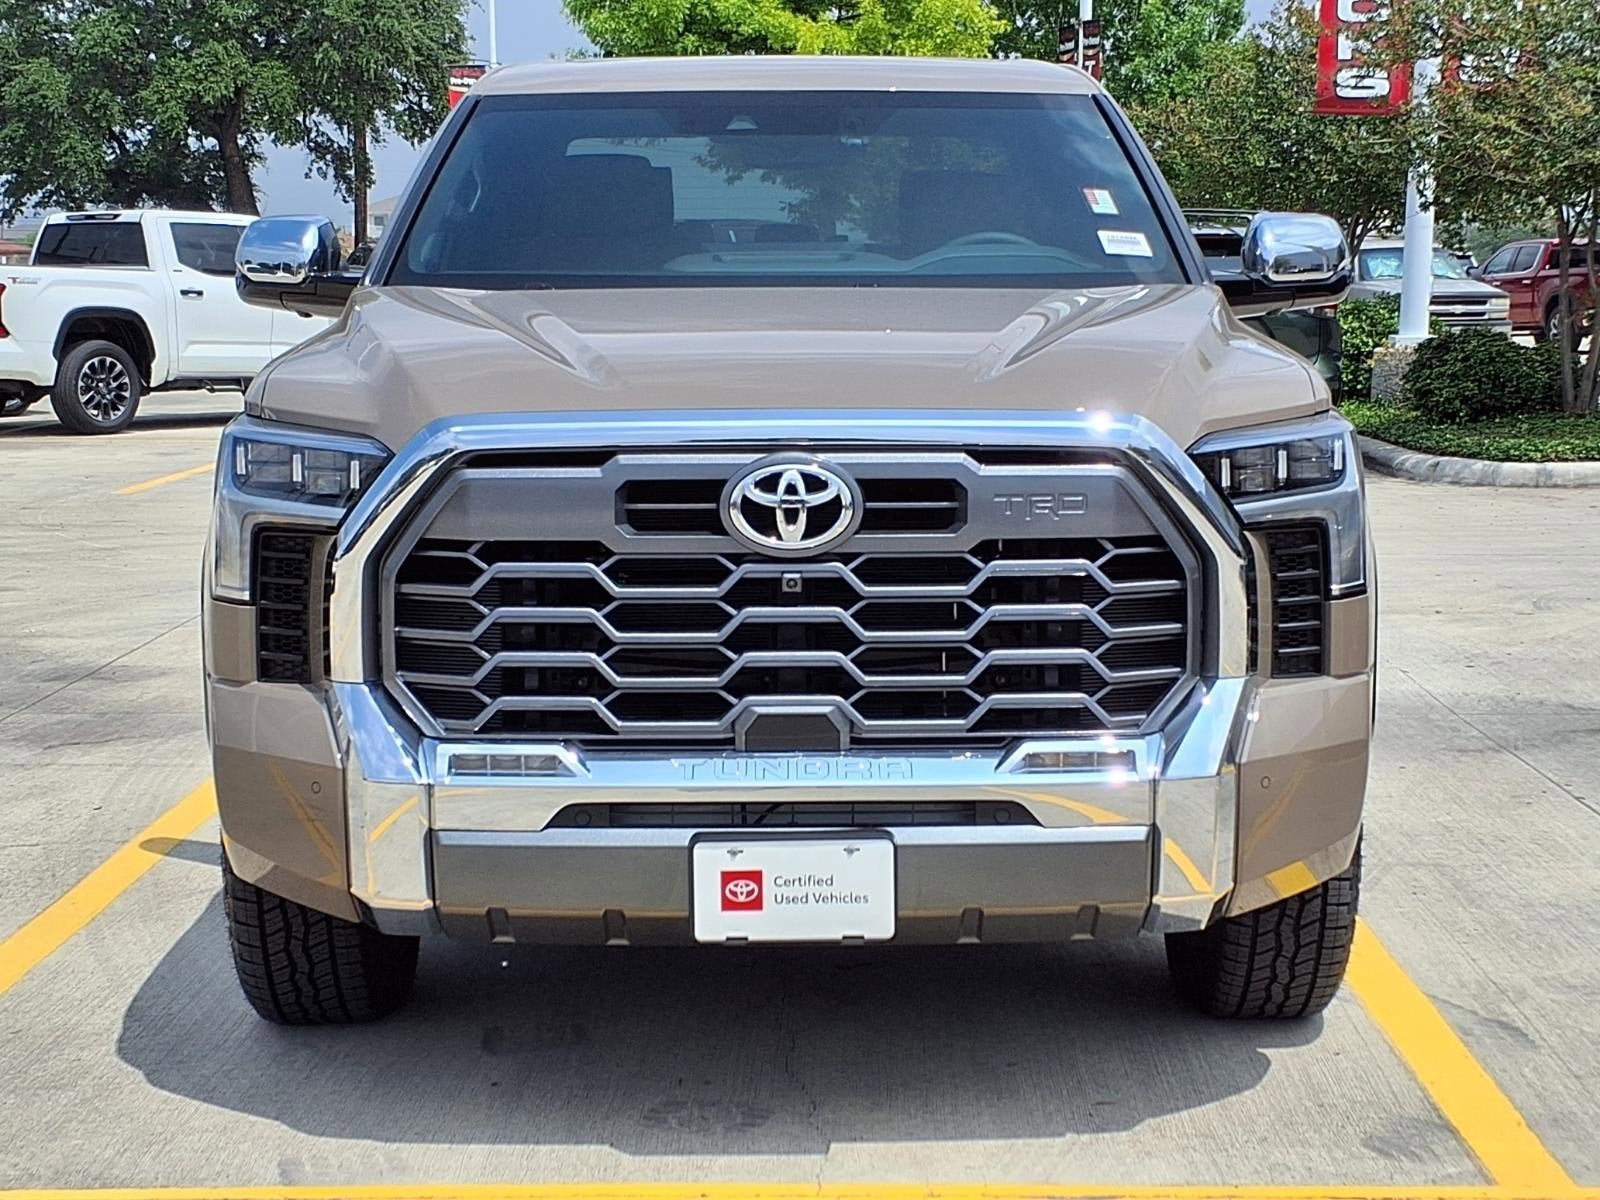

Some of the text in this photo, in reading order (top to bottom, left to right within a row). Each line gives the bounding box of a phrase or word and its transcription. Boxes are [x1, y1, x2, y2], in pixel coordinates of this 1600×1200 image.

[993, 493, 1088, 521] TRD
[671, 757, 914, 781] TUNDRA
[773, 873, 834, 888] Certified
[774, 890, 869, 905] Used Vehicles
